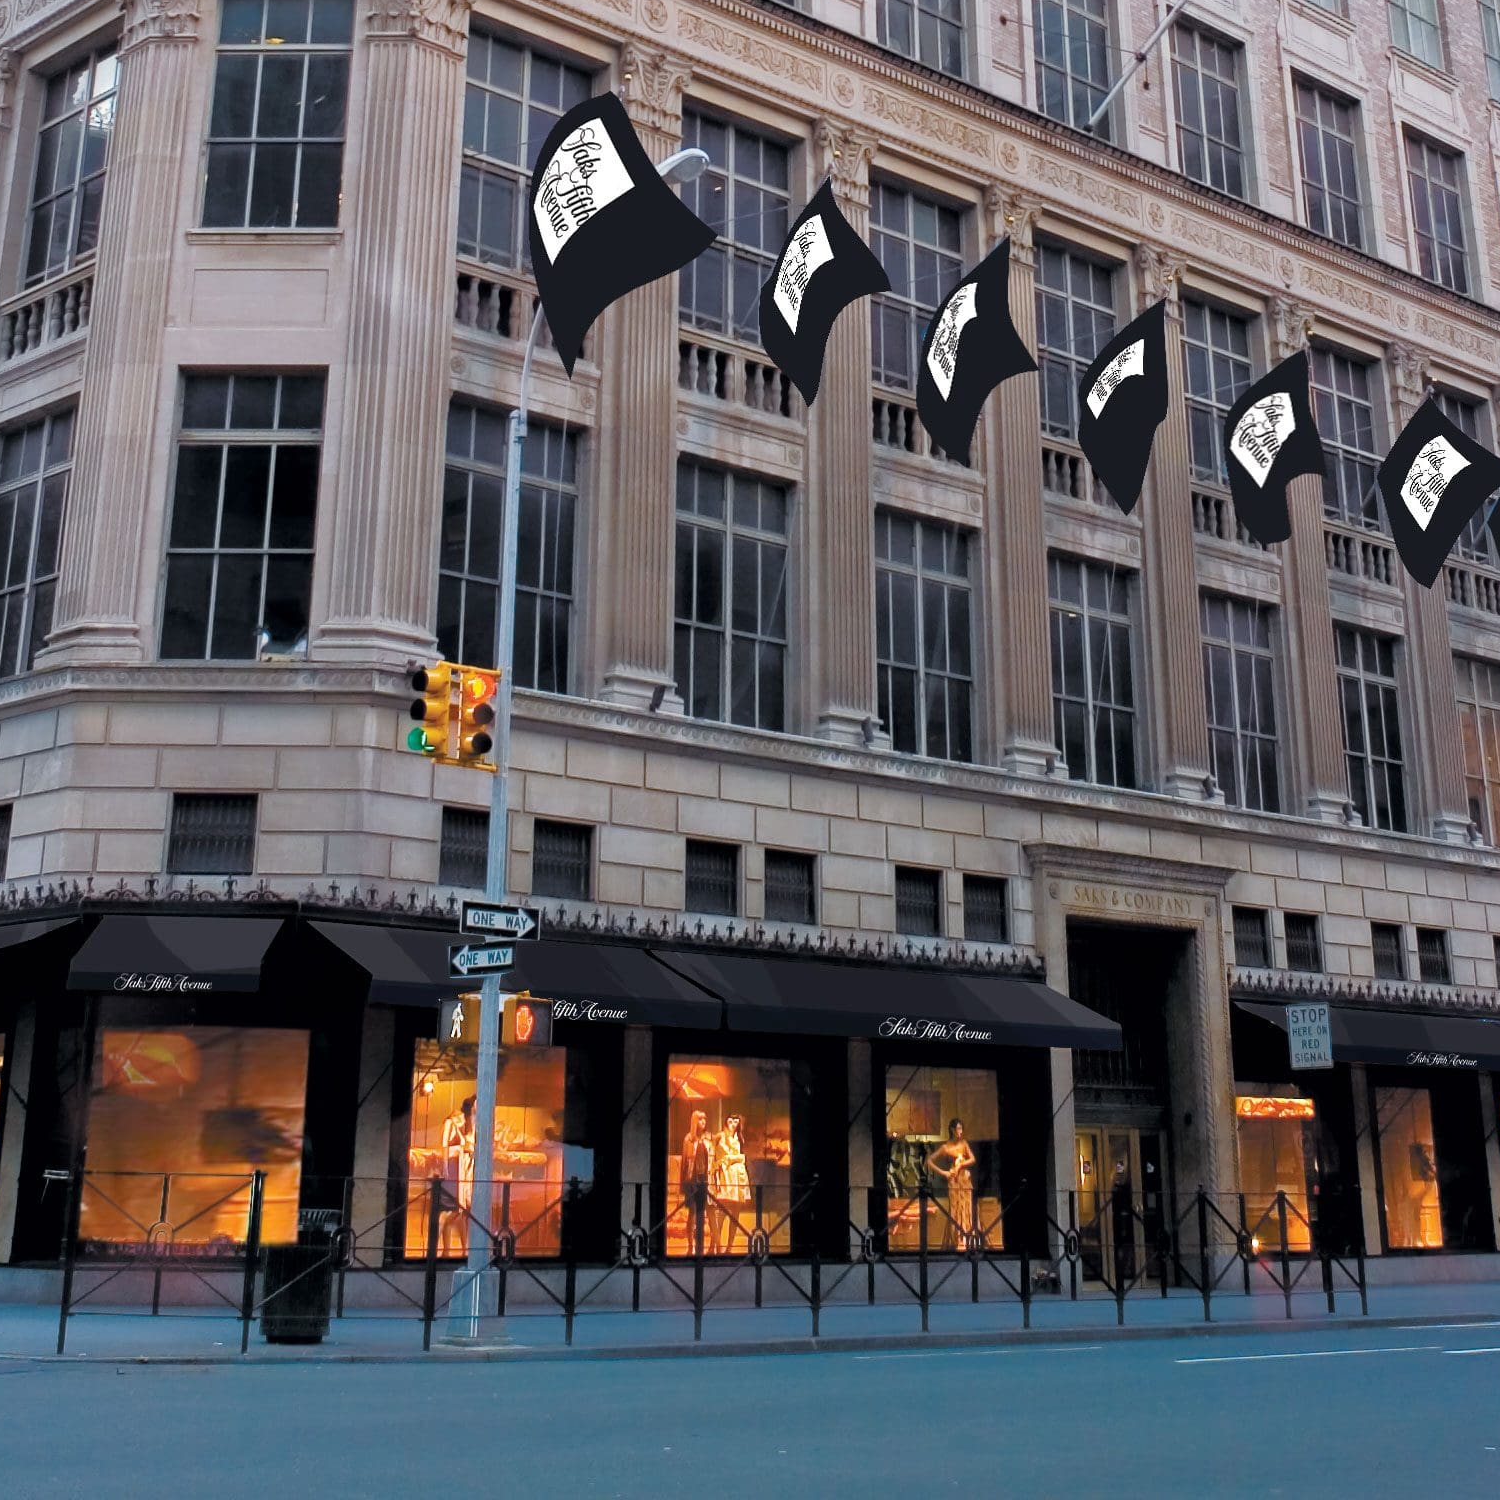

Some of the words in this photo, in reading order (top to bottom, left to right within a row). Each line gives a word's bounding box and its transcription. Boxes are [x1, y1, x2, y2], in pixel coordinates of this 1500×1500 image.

[561, 128, 602, 179] Saks
[538, 160, 569, 238] Avenue
[556, 167, 597, 227] Fifth
[1254, 396, 1285, 427] Saks
[1234, 413, 1269, 468] Avenue
[1074, 884, 1107, 904] SAKS
[1112, 890, 1119, 906] &
[1124, 891, 1192, 914] COMPANY
[473, 912, 496, 926] ONE
[505, 916, 528, 930] WAY
[459, 953, 479, 967] ONE
[487, 950, 509, 965] WAY
[114, 973, 146, 990] Saks
[142, 974, 173, 991] Fifth
[166, 974, 212, 992] Avenue
[572, 1000, 628, 1021] Avenue
[1292, 1008, 1326, 1023] STOP
[879, 1017, 917, 1036] Saks
[912, 1019, 947, 1038] Fifth
[940, 1022, 992, 1040] Avenue
[1292, 1026, 1313, 1036] HERE
[1317, 1025, 1328, 1035] ON
[1301, 1039, 1320, 1049] RED
[1295, 1052, 1329, 1063] SIGNAL
